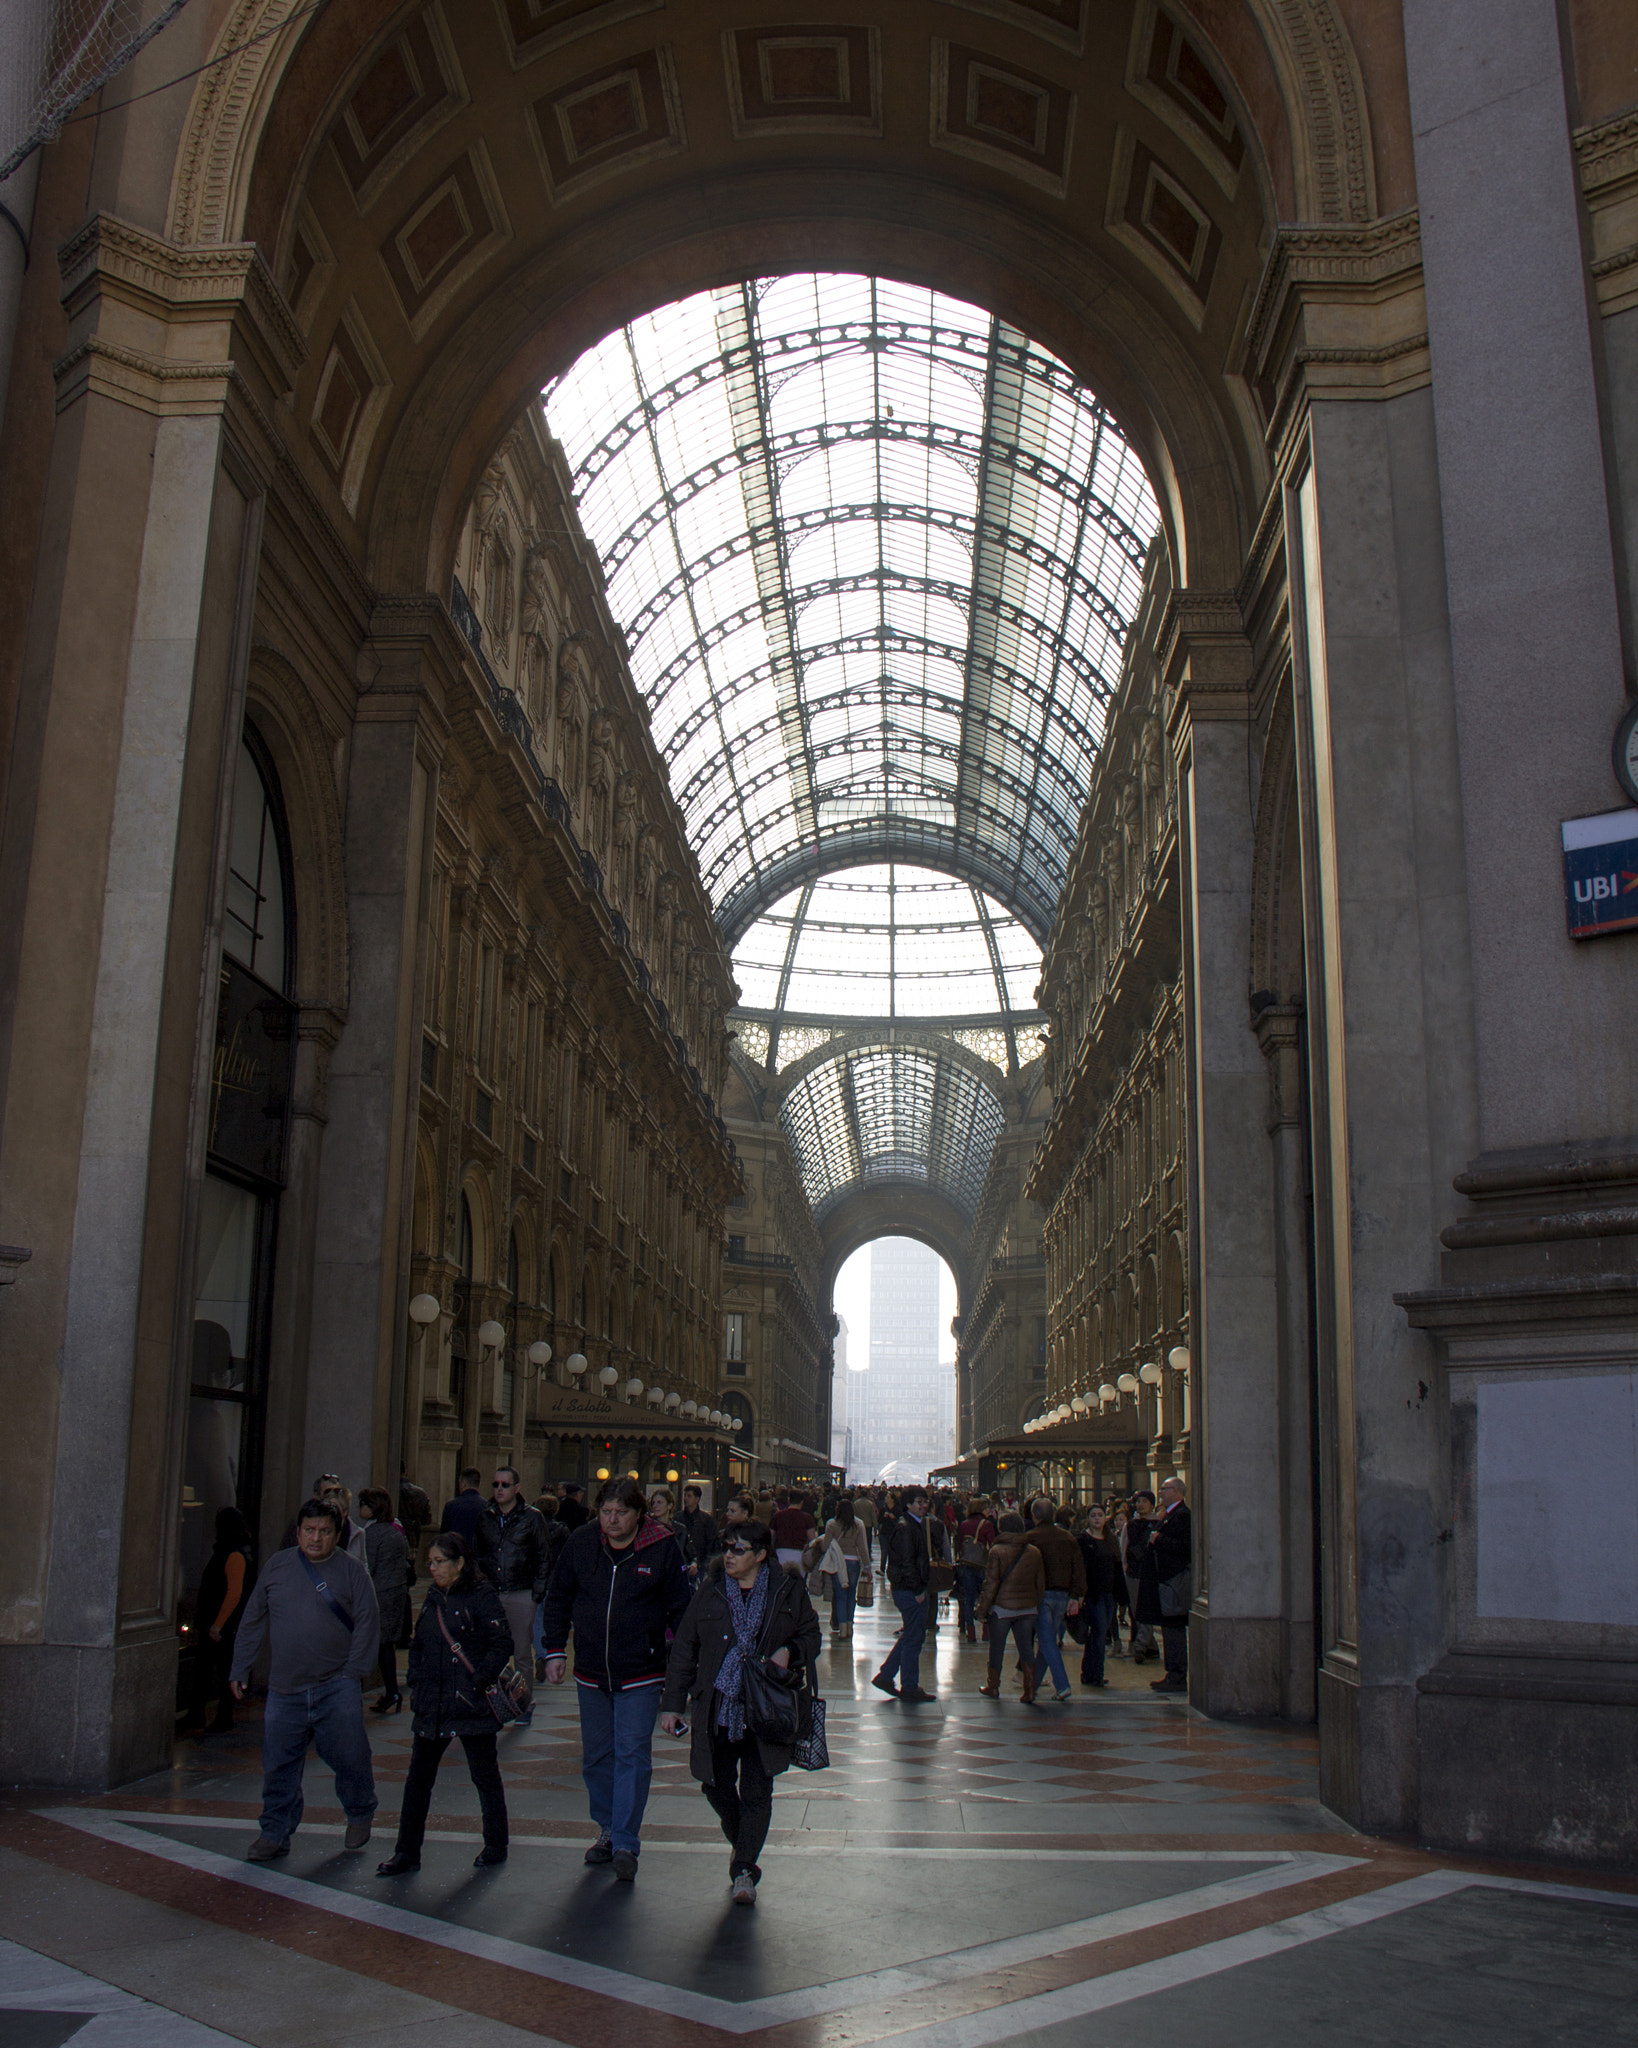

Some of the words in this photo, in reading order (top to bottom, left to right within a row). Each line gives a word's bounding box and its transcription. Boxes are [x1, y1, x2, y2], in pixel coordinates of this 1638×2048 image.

[1573, 873, 1618, 903] UBI
[551, 1398, 563, 1411] il
[566, 1398, 612, 1413] Salotto
